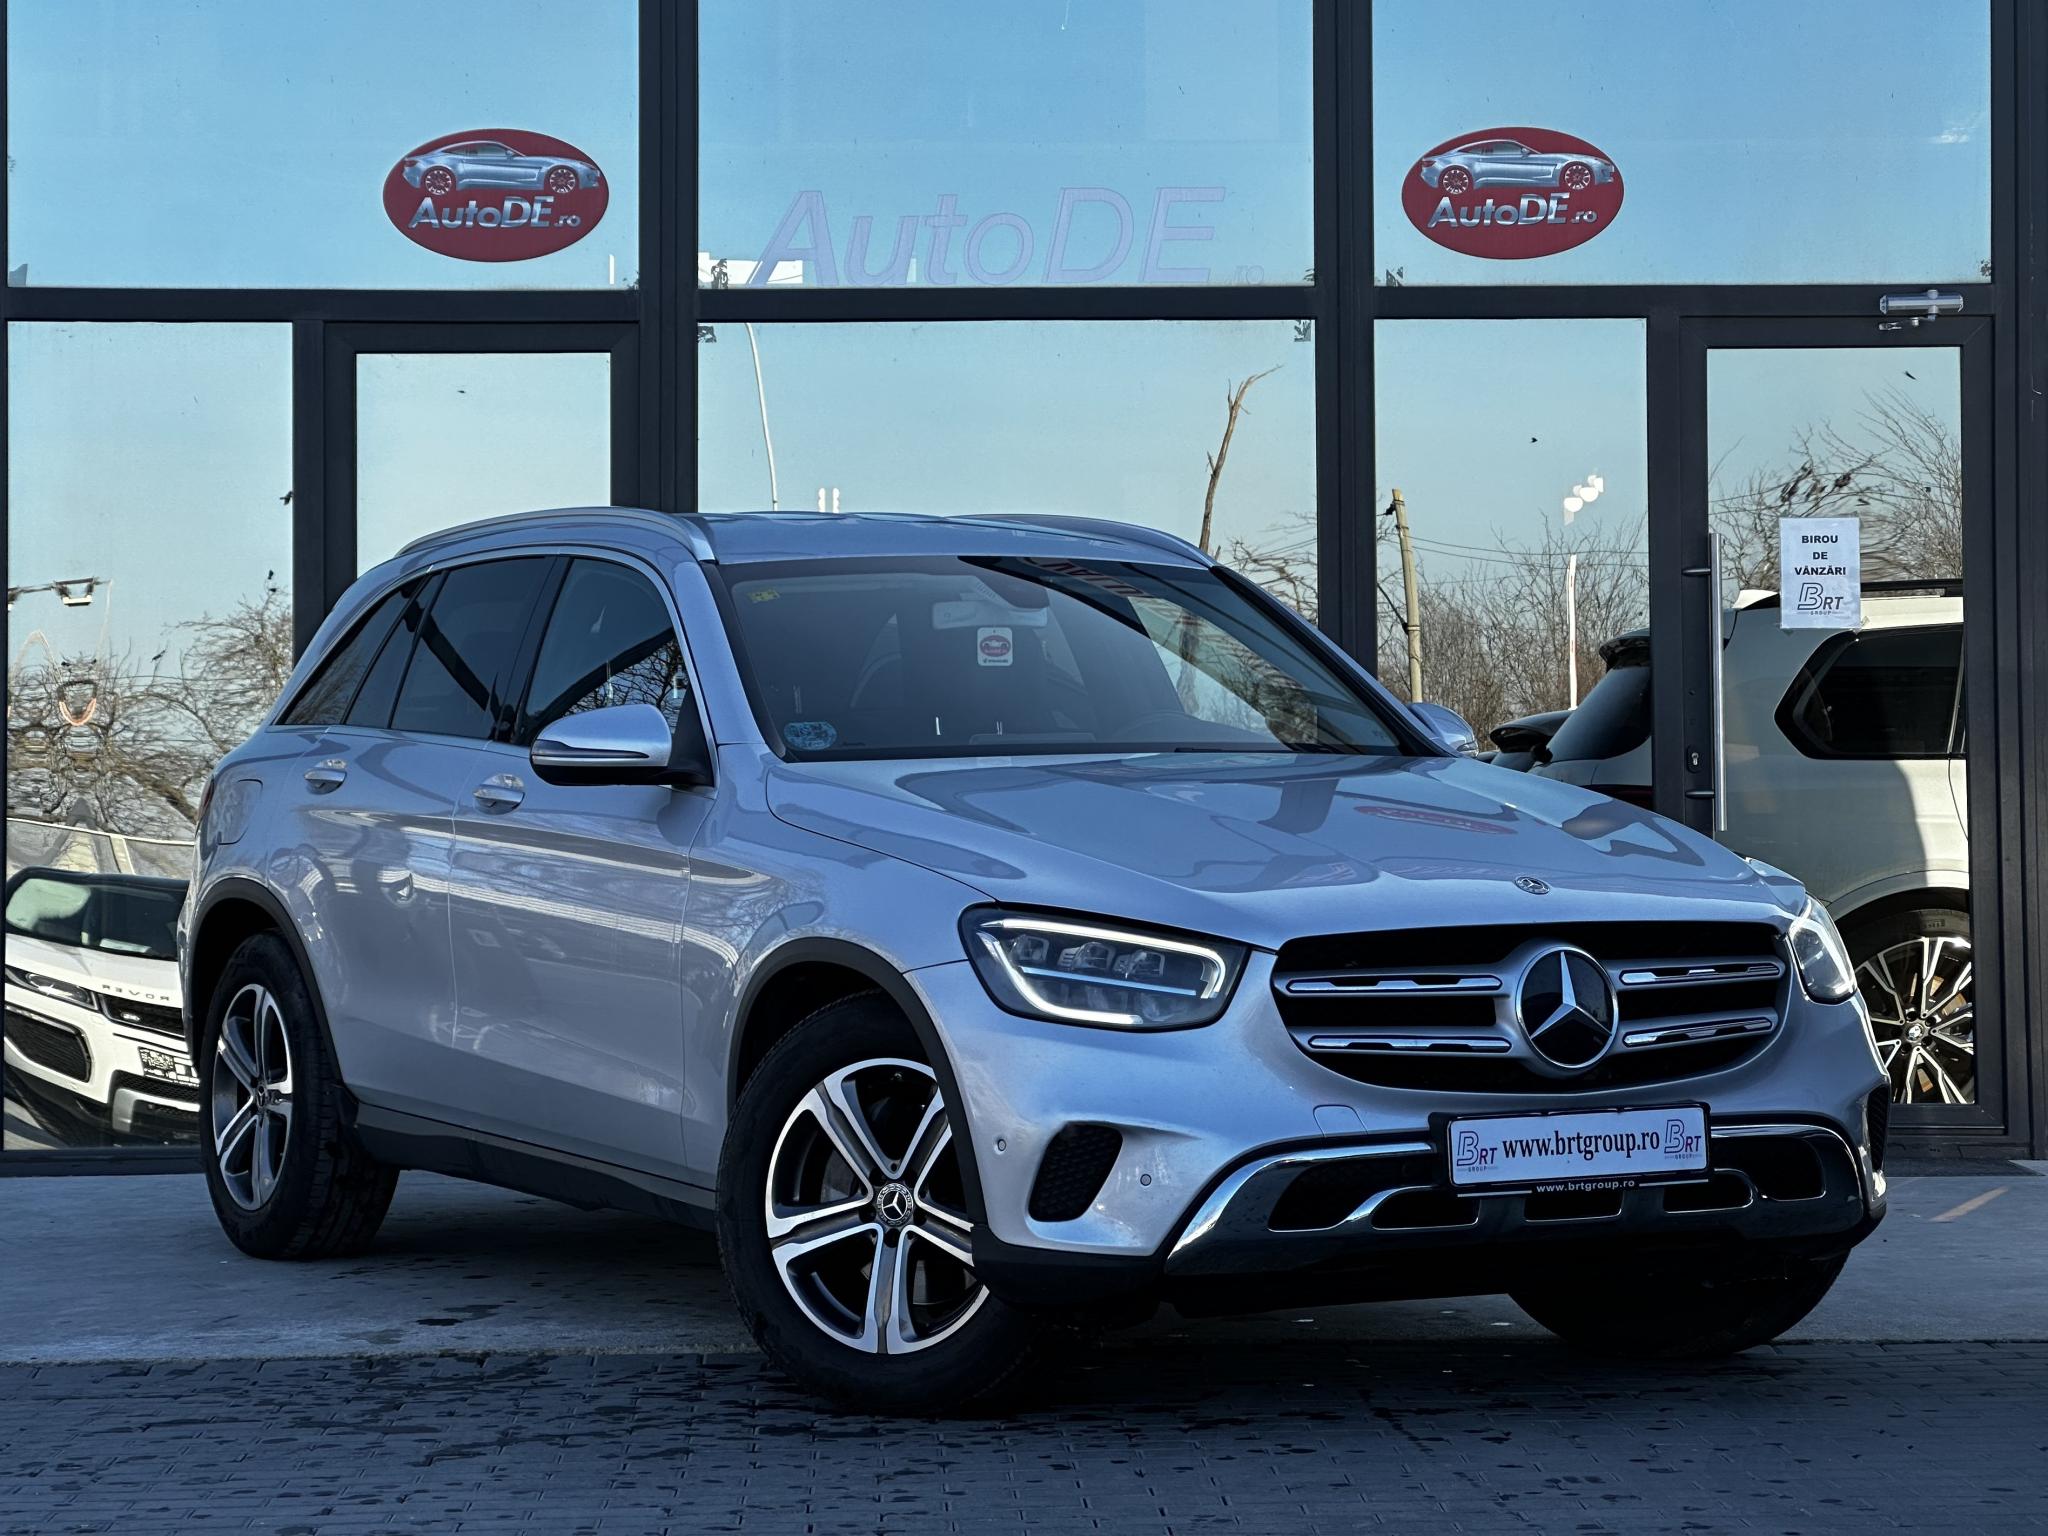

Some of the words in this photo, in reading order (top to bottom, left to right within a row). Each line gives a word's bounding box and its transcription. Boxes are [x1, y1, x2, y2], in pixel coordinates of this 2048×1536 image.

[1801, 535, 1838, 543] BIROU
[1812, 551, 1828, 560] DE
[1797, 582, 1844, 610] BRT
[1456, 1130, 1498, 1166] BRT
[1502, 1130, 1660, 1160] www.brtgroup.ro
[1663, 1118, 1702, 1154] BRT
[1536, 1179, 1636, 1193] www.brtgroup.ro
